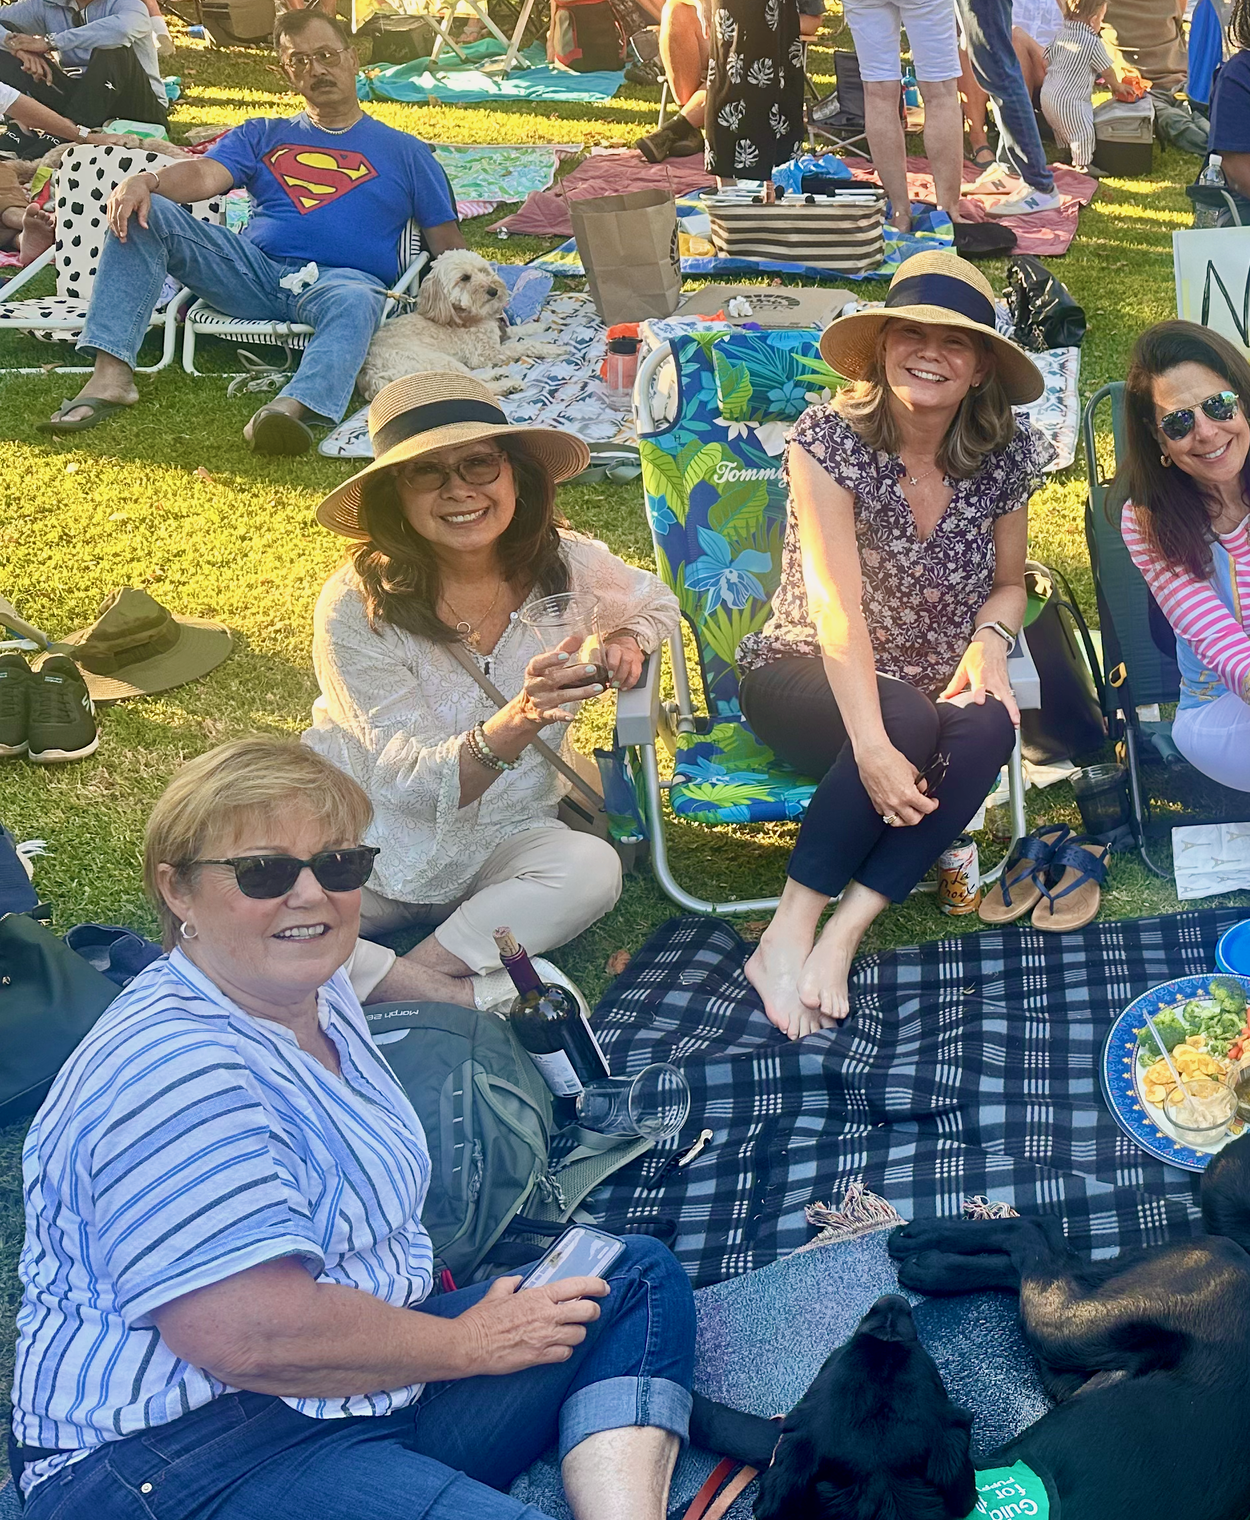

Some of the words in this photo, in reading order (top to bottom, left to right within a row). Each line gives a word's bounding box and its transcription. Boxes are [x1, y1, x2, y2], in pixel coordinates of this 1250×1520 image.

[1024, 197, 1040, 210] N
[384, 1009, 419, 1019] Morph
[995, 1483, 1027, 1500] for
